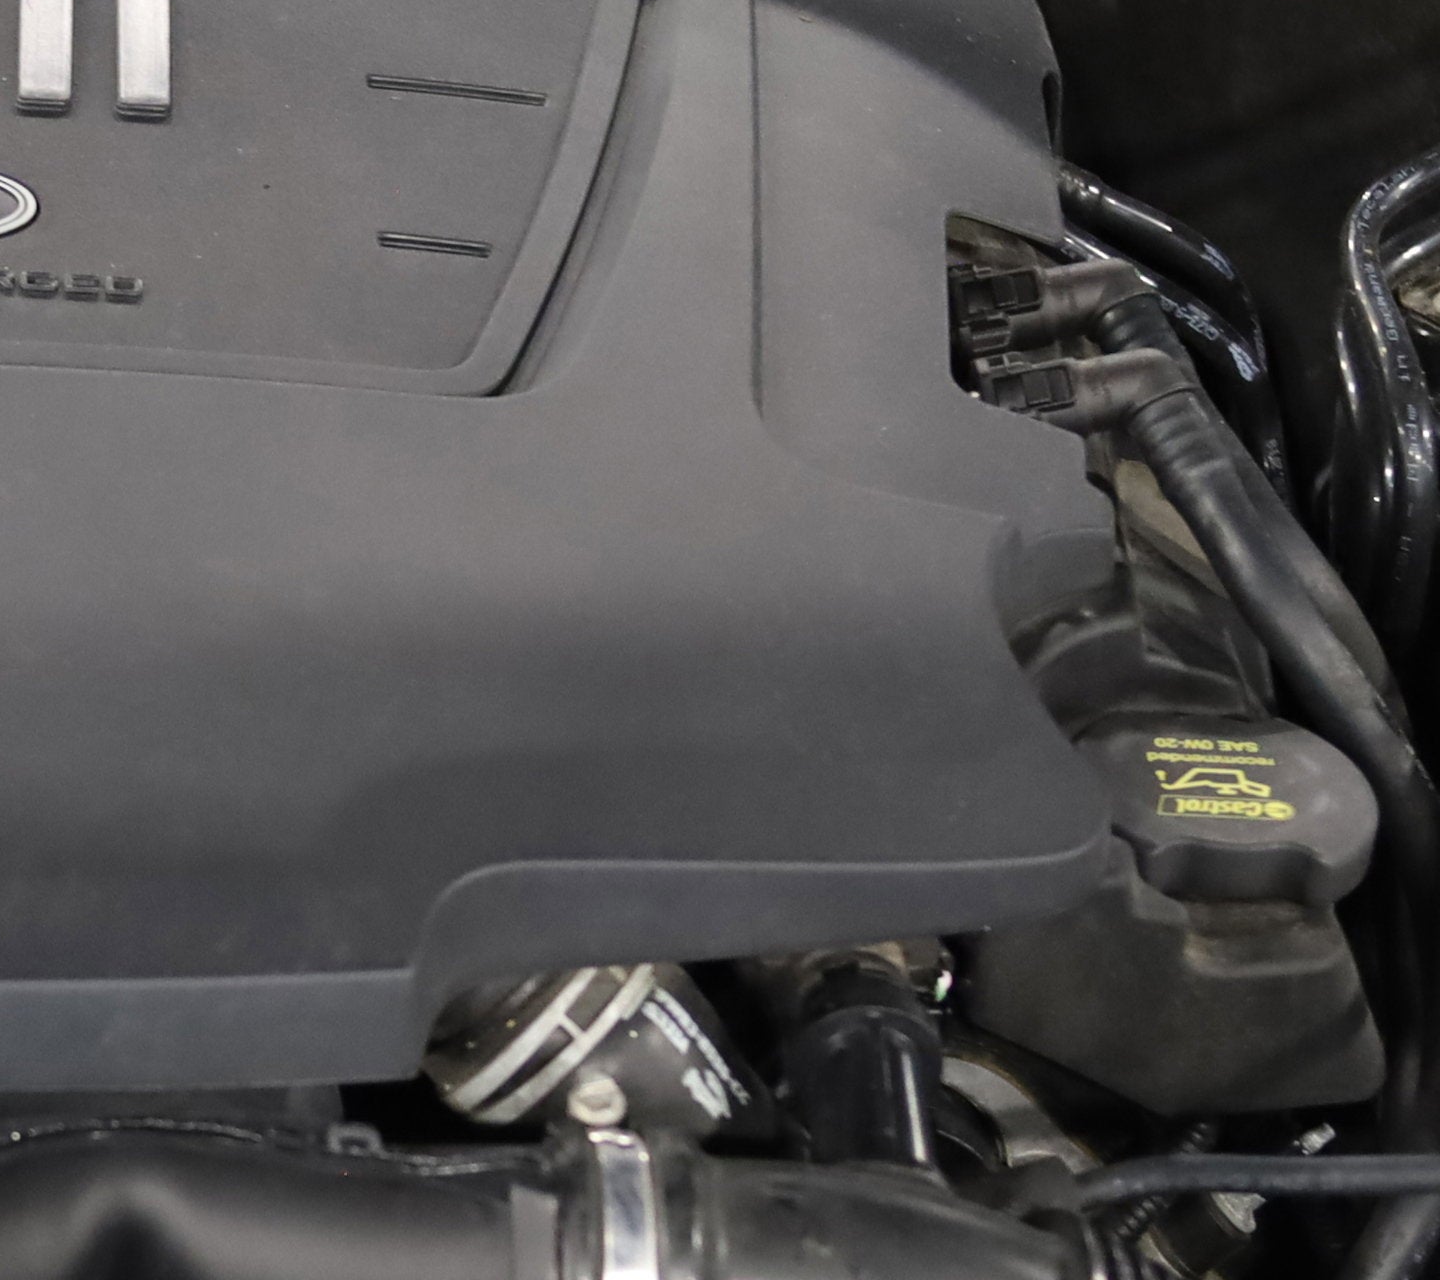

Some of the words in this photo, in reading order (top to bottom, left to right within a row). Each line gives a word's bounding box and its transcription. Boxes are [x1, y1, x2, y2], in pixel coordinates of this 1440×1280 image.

[1153, 736, 1215, 751] 0W-20
[1216, 739, 1260, 753] SAE
[1145, 751, 1276, 766] recommended
[1175, 798, 1264, 818] Castrol
